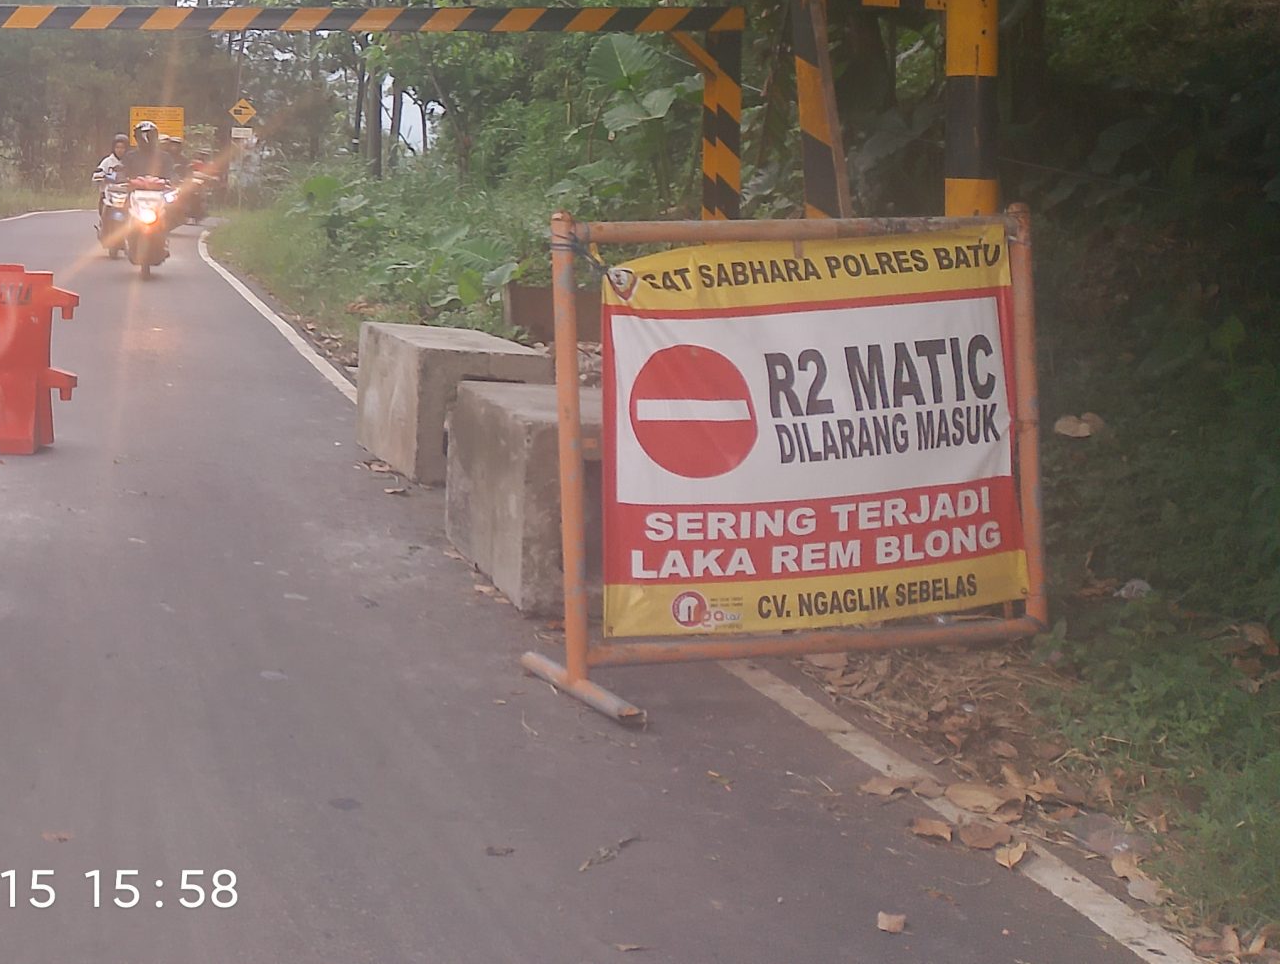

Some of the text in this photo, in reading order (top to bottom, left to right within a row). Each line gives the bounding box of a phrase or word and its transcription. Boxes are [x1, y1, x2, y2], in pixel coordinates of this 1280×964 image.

[642, 239, 1001, 292] SAT SABHARA POLRES BATU
[764, 334, 996, 419] R2 MATIC
[775, 403, 1001, 464] DILARANG MASUK
[644, 486, 990, 542] SERING TERJADI
[631, 521, 1001, 579] LAKA REM BLONG
[757, 573, 977, 619] CV. NGAGLIK SEBELAS
